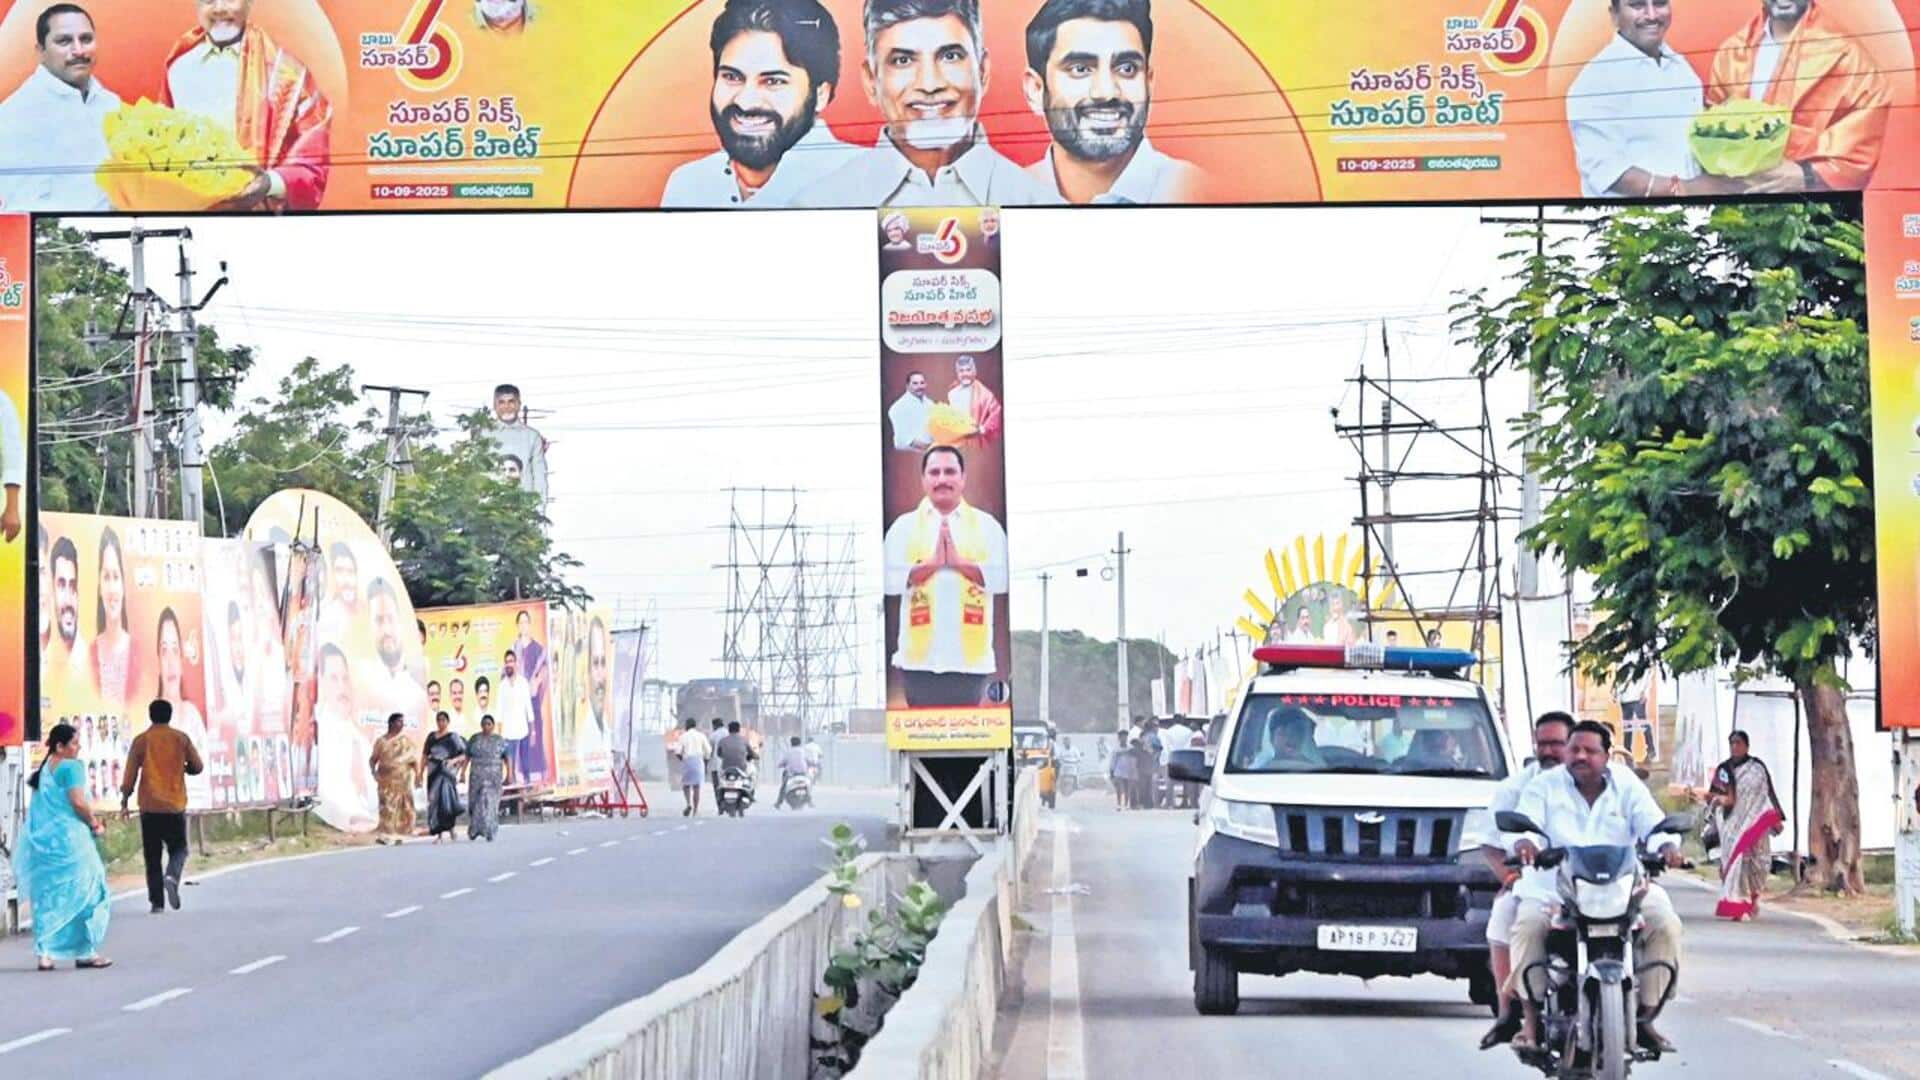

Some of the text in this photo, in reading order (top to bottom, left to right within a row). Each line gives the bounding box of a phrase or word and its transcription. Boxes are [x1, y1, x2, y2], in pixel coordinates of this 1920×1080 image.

[1447, 30, 1514, 50] సూపర్
[362, 46, 429, 66] సూపర్
[1351, 64, 1483, 98] సూపర్ సిక్స్
[390, 97, 521, 130] సూపర్ సిక్స్
[1331, 94, 1502, 125] సూపర్ హిట్
[370, 128, 540, 157] సూపర్ హిట్
[1340, 160, 1415, 170] 10-09-2025
[374, 186, 448, 197] 10-09-2025
[904, 288, 945, 301] సూపర్
[1332, 695, 1401, 708] POLICE
